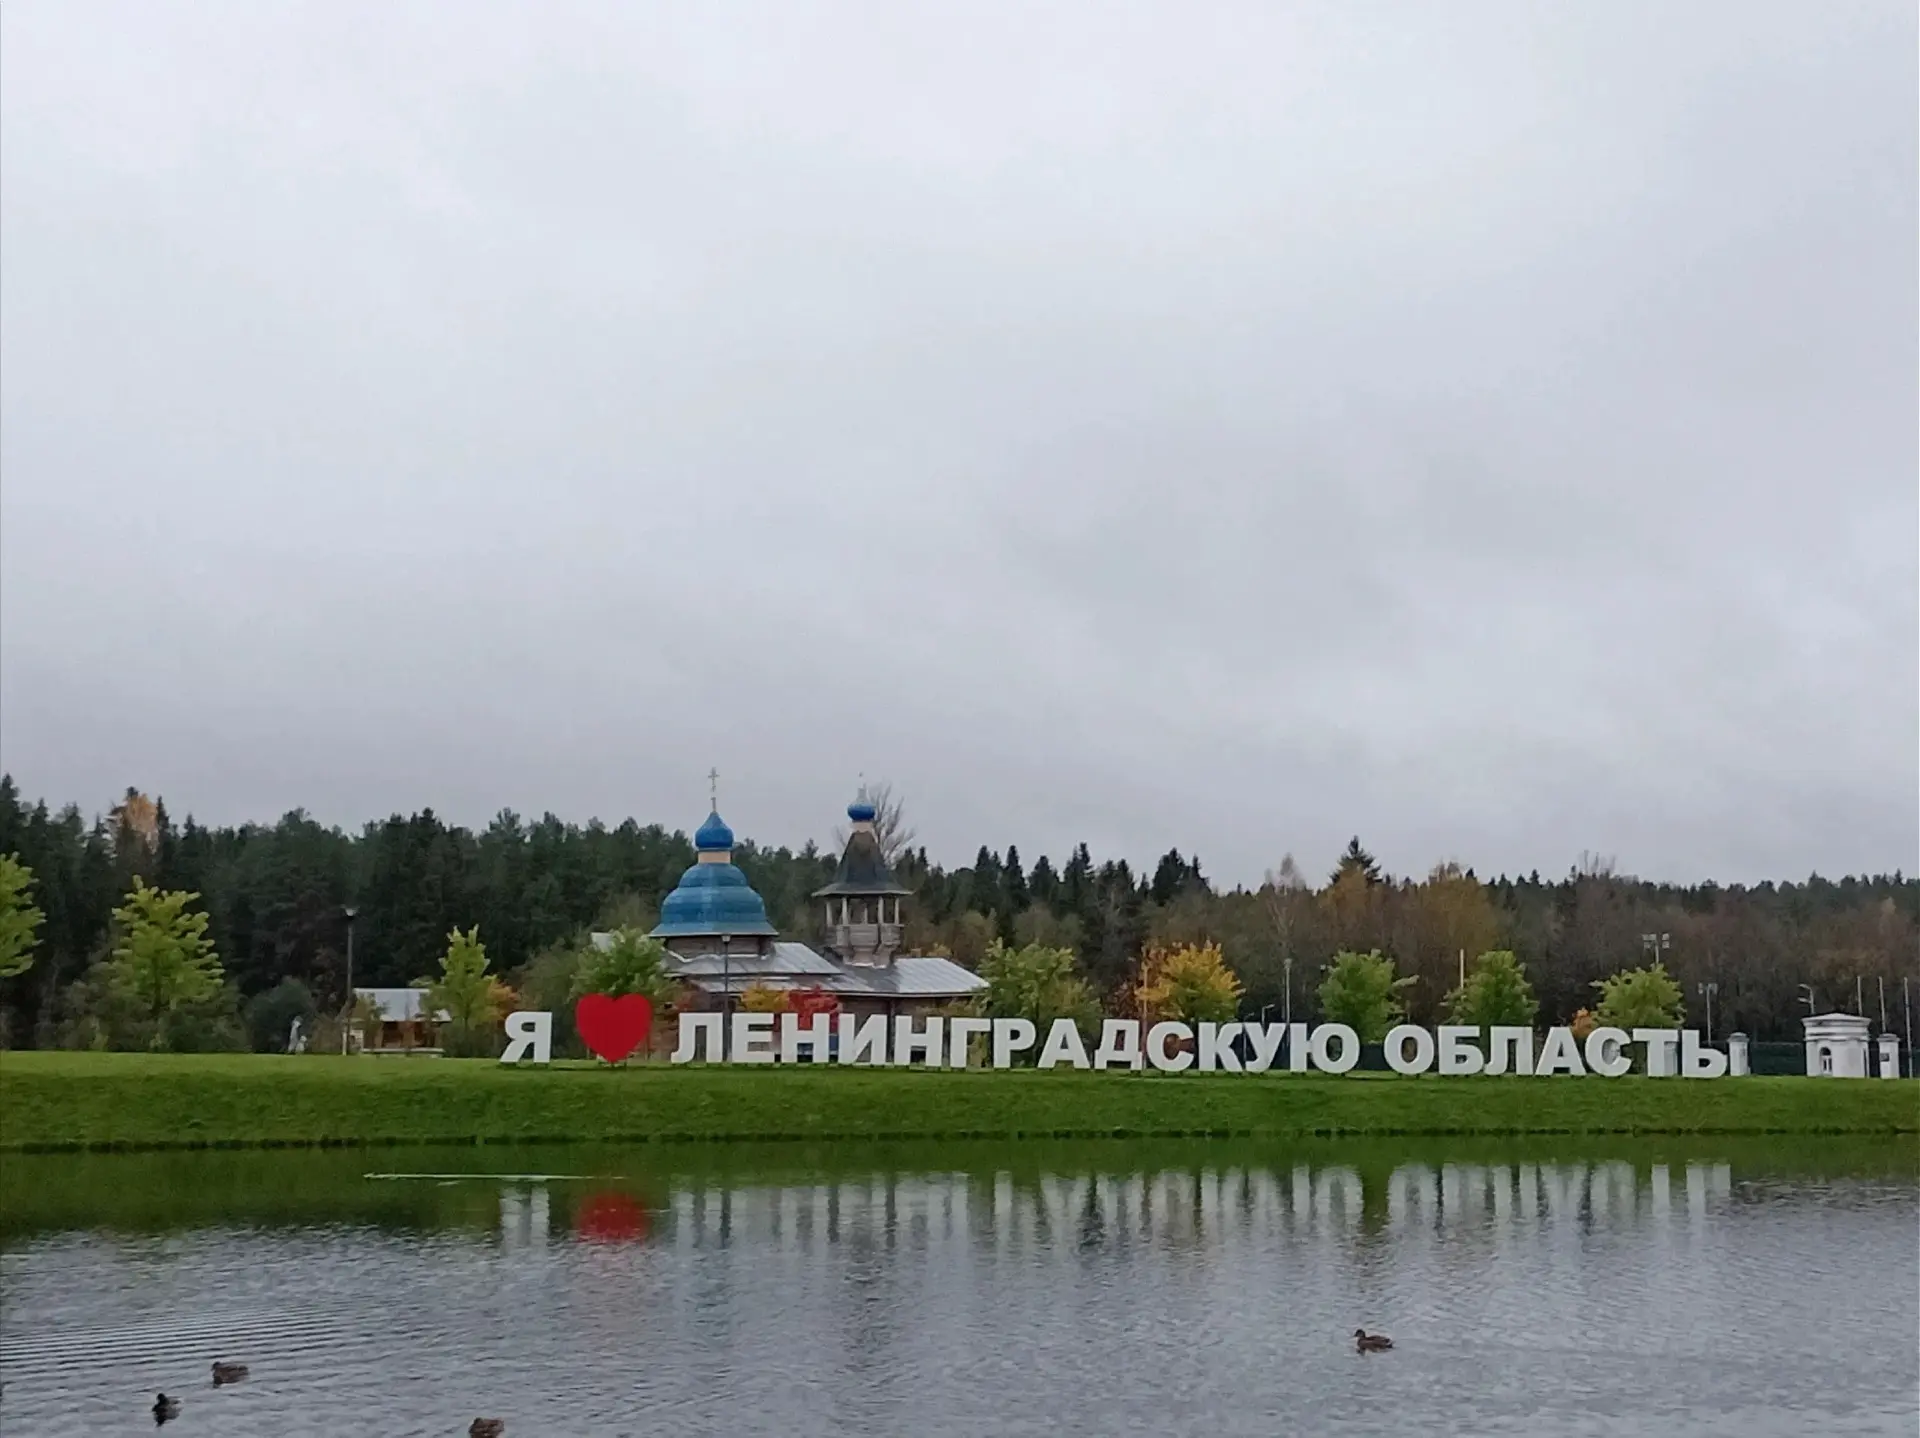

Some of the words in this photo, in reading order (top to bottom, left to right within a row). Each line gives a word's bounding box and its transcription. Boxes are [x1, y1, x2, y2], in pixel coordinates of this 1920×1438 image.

[501, 1011, 553, 1064] Я
[670, 1012, 1360, 1073] ЛЕНИНГРАДСКУЮ
[1383, 1024, 1728, 1079] ОБЛАСТЬ
